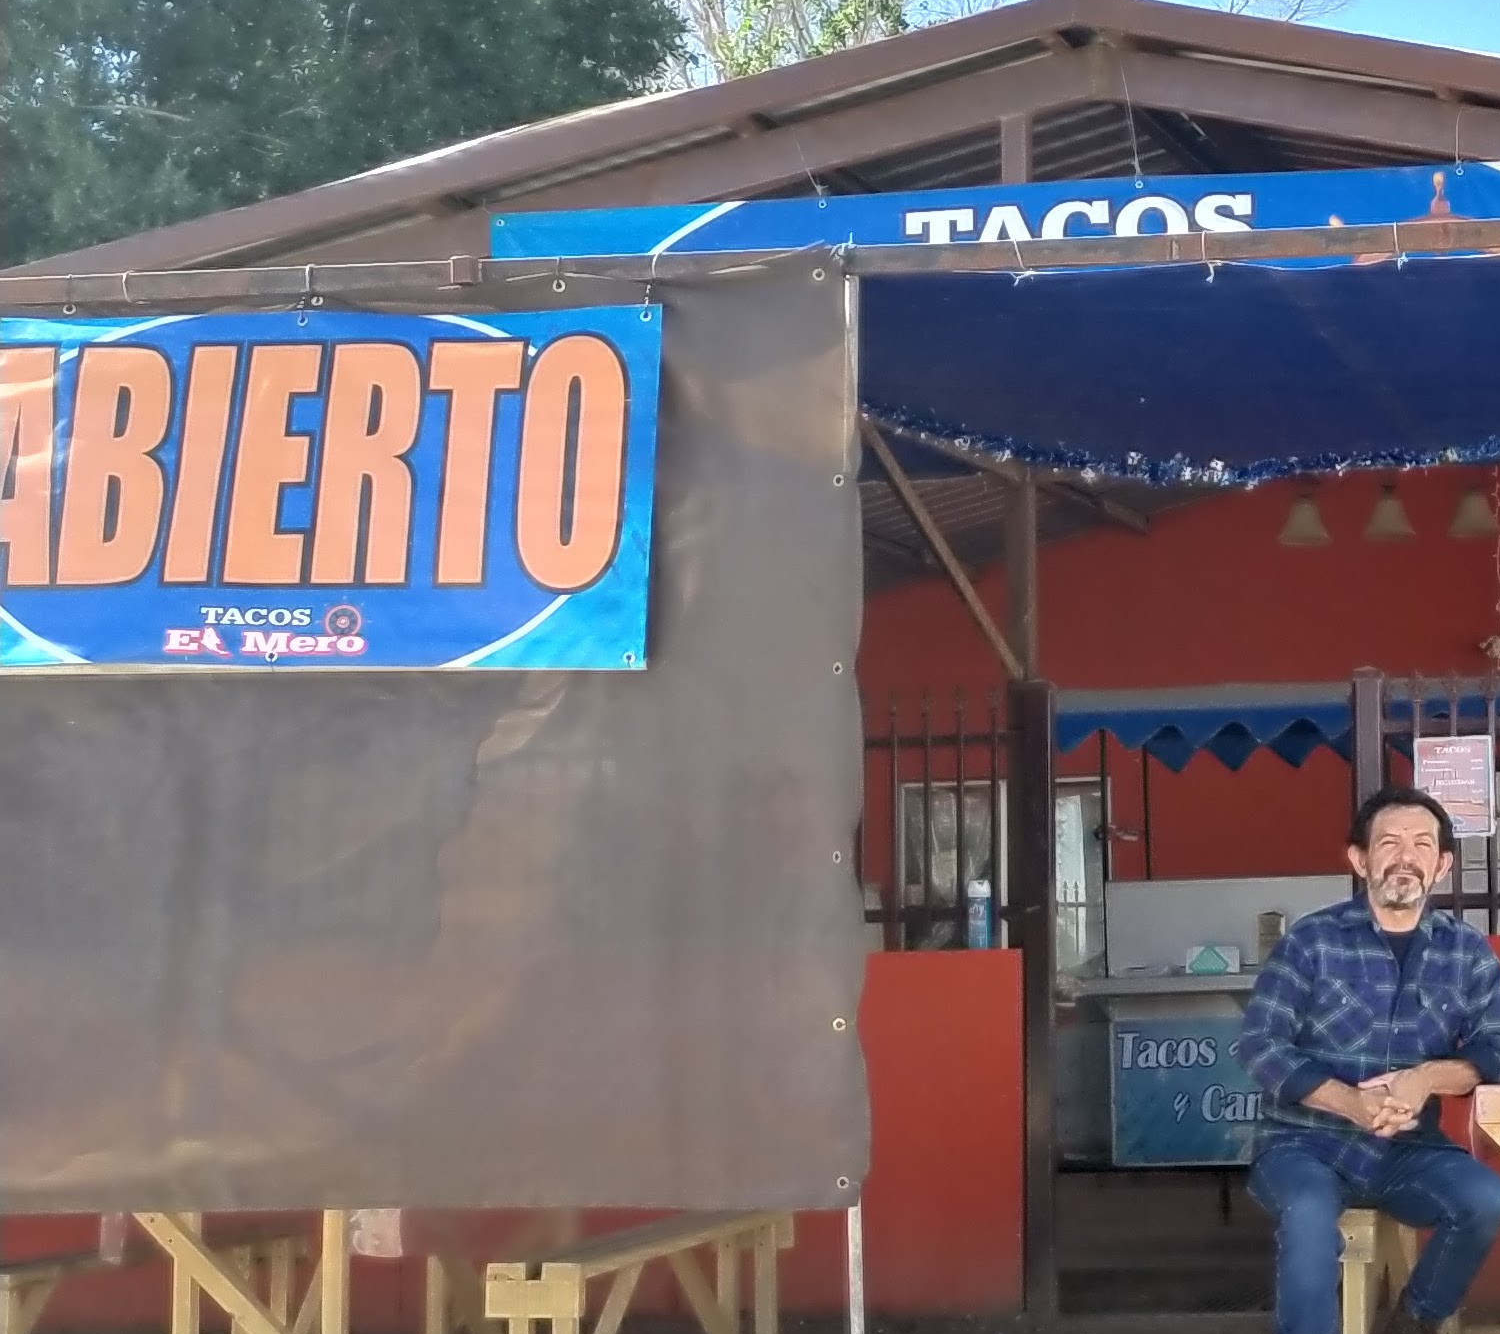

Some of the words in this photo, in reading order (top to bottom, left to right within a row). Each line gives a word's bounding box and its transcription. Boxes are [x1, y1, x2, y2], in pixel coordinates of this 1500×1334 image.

[905, 193, 1252, 244] TACOS
[0, 334, 630, 594] ABIERTO
[200, 605, 312, 626] TACOS
[240, 630, 366, 655] Mero
[1116, 1031, 1217, 1069] Tacos
[1172, 1091, 1191, 1123] y
